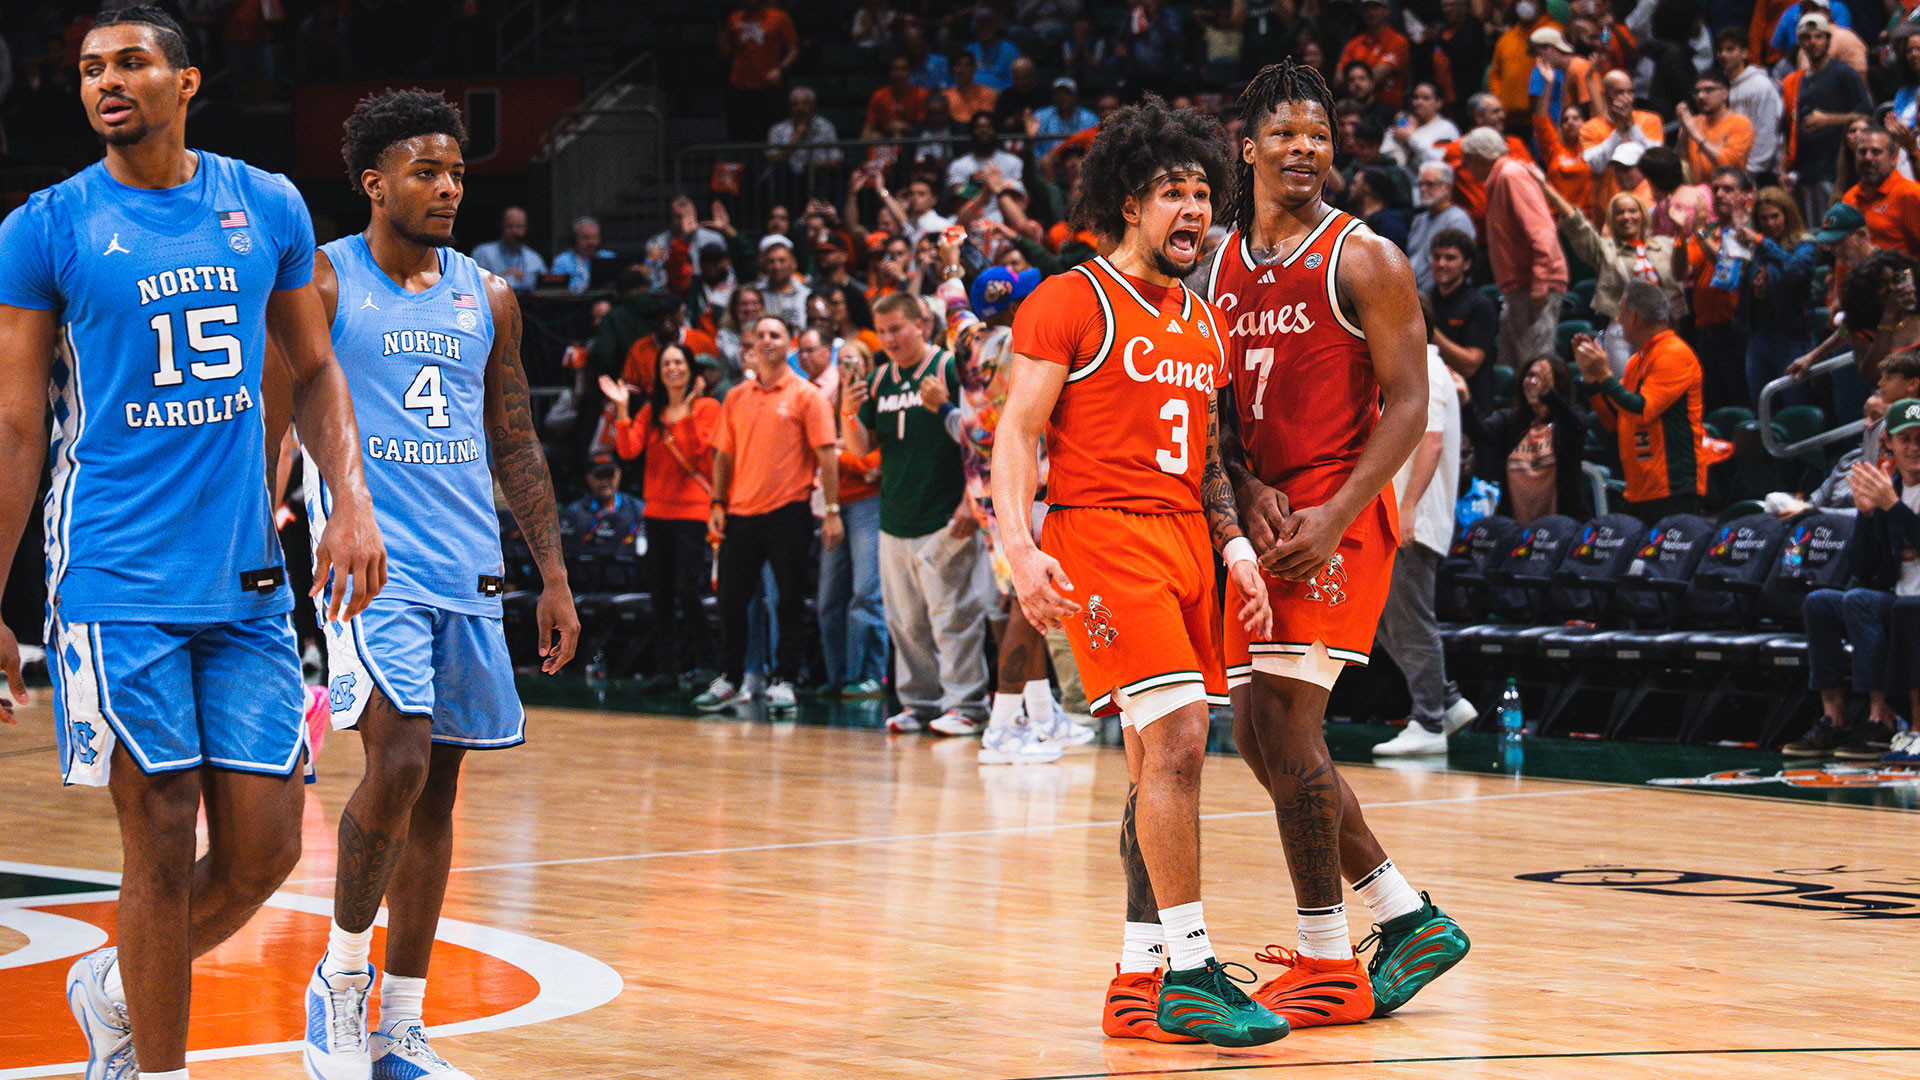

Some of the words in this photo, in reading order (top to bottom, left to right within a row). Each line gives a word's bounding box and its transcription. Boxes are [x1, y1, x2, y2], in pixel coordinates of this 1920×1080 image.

[137, 266, 239, 306] NORTH
[1216, 293, 1315, 337] Canes
[150, 304, 243, 387] 15
[383, 330, 461, 361] NORTH
[1123, 336, 1214, 395] Canes
[404, 364, 450, 428] 4
[1245, 347, 1274, 420] 7
[877, 389, 923, 413] MIAM
[897, 410, 906, 439] 1
[1155, 398, 1189, 475] 3
[368, 435, 479, 464] CAROLINA
[1661, 540, 1692, 550] National
[1666, 528, 1682, 542] City
[1734, 540, 1766, 549] National
[1738, 527, 1755, 541] City
[1810, 539, 1847, 550] National
[1815, 526, 1832, 541] City
[1808, 550, 1829, 560] Bank
